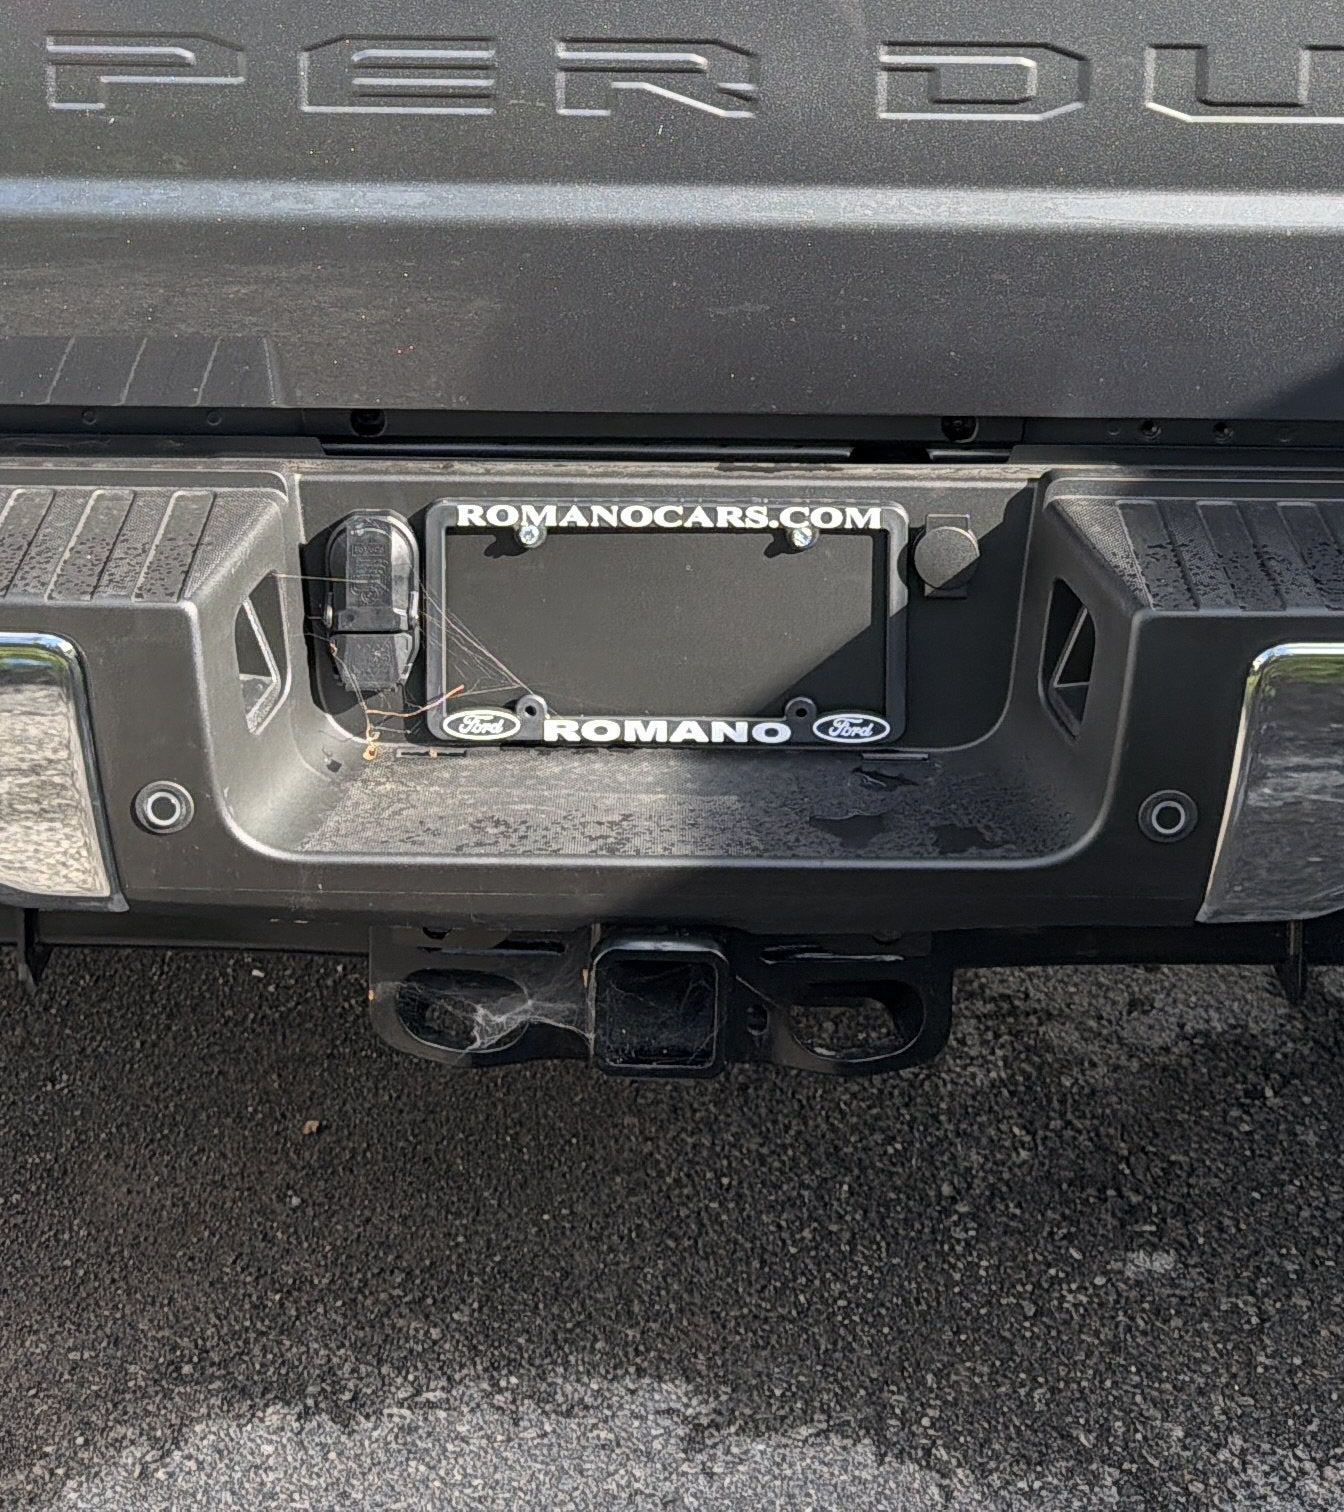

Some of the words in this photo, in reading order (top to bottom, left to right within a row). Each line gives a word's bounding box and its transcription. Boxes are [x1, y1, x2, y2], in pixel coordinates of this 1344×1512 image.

[456, 503, 883, 530] ROMANOCARS.COM
[458, 714, 504, 735] Ford
[543, 719, 792, 743] ROMANO
[828, 716, 874, 738] Ford
